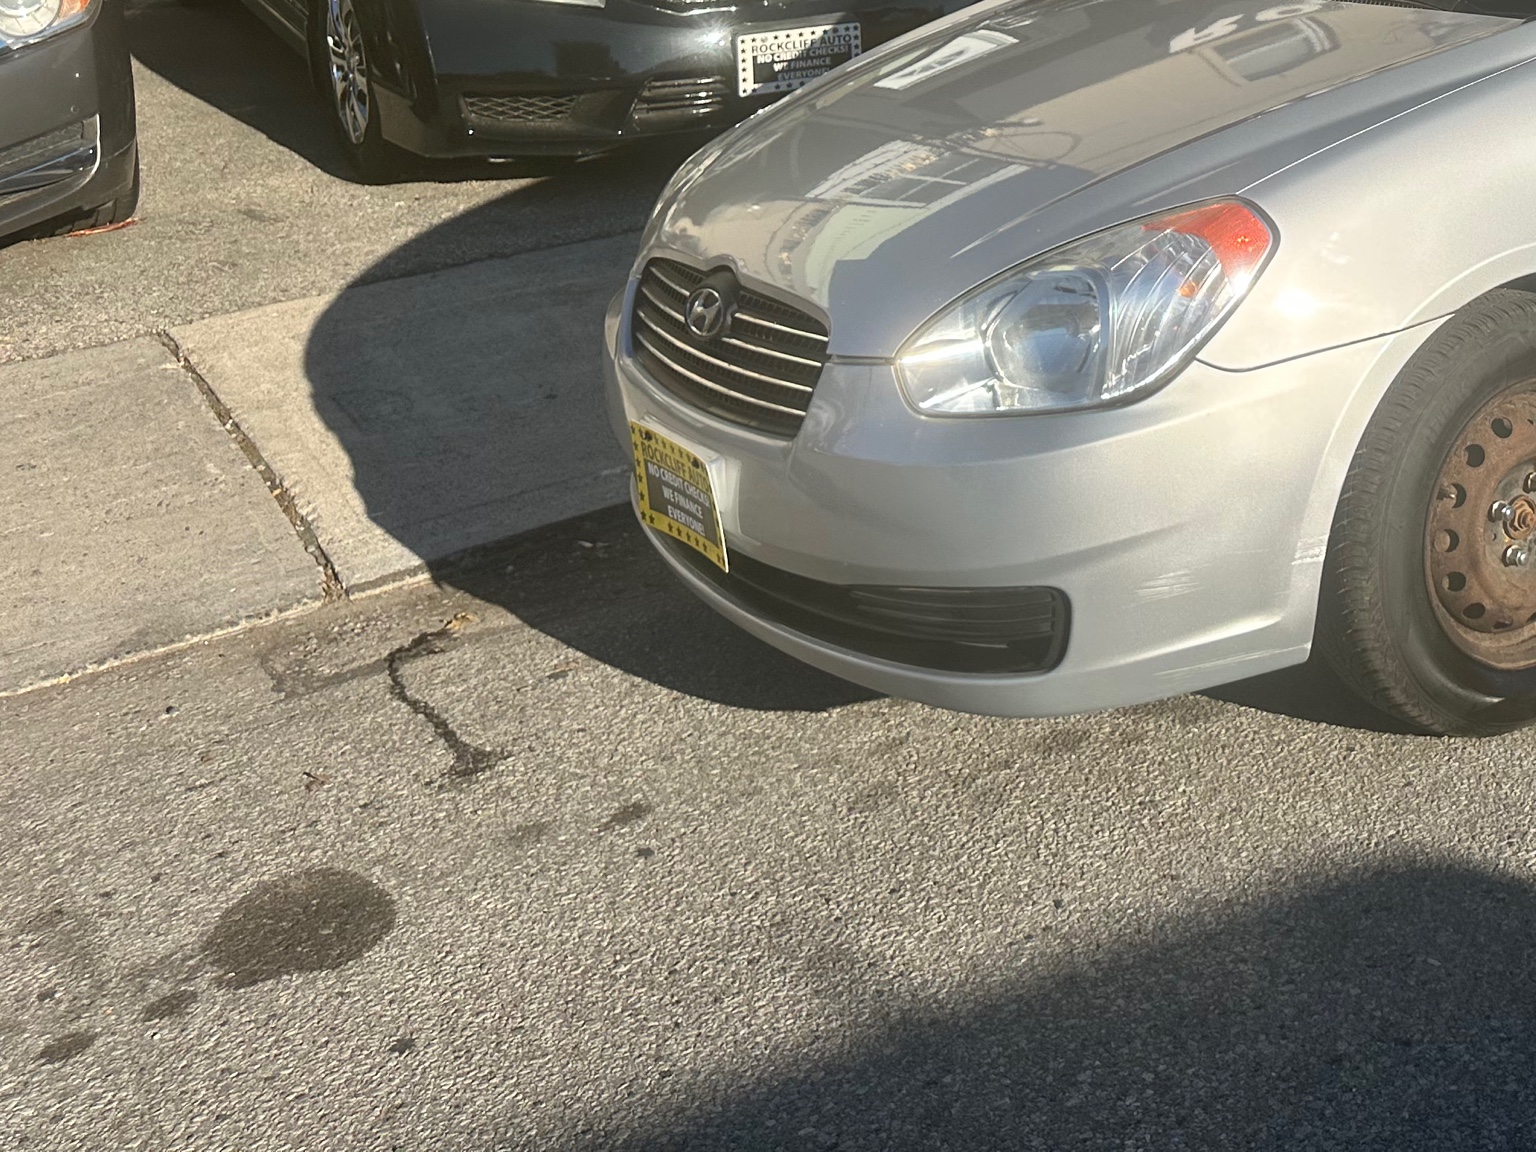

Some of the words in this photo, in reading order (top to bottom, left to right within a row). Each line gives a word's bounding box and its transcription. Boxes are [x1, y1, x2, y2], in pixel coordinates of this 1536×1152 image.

[751, 38, 818, 54] ROCKCLIFF
[820, 33, 852, 47] AUTO
[757, 53, 773, 64] NO
[773, 50, 807, 62] CREDIT
[809, 45, 849, 57] CHECKS!
[773, 61, 788, 72] WE
[790, 56, 832, 69] FINANCE
[641, 442, 686, 476] ROCKCLIFF
[648, 462, 660, 476] NO
[660, 468, 684, 491] CREDIT
[684, 481, 710, 508] CHECKS!
[662, 485, 675, 500] WE
[674, 492, 704, 519] FINANCE
[667, 506, 706, 537] EVERYONE!
